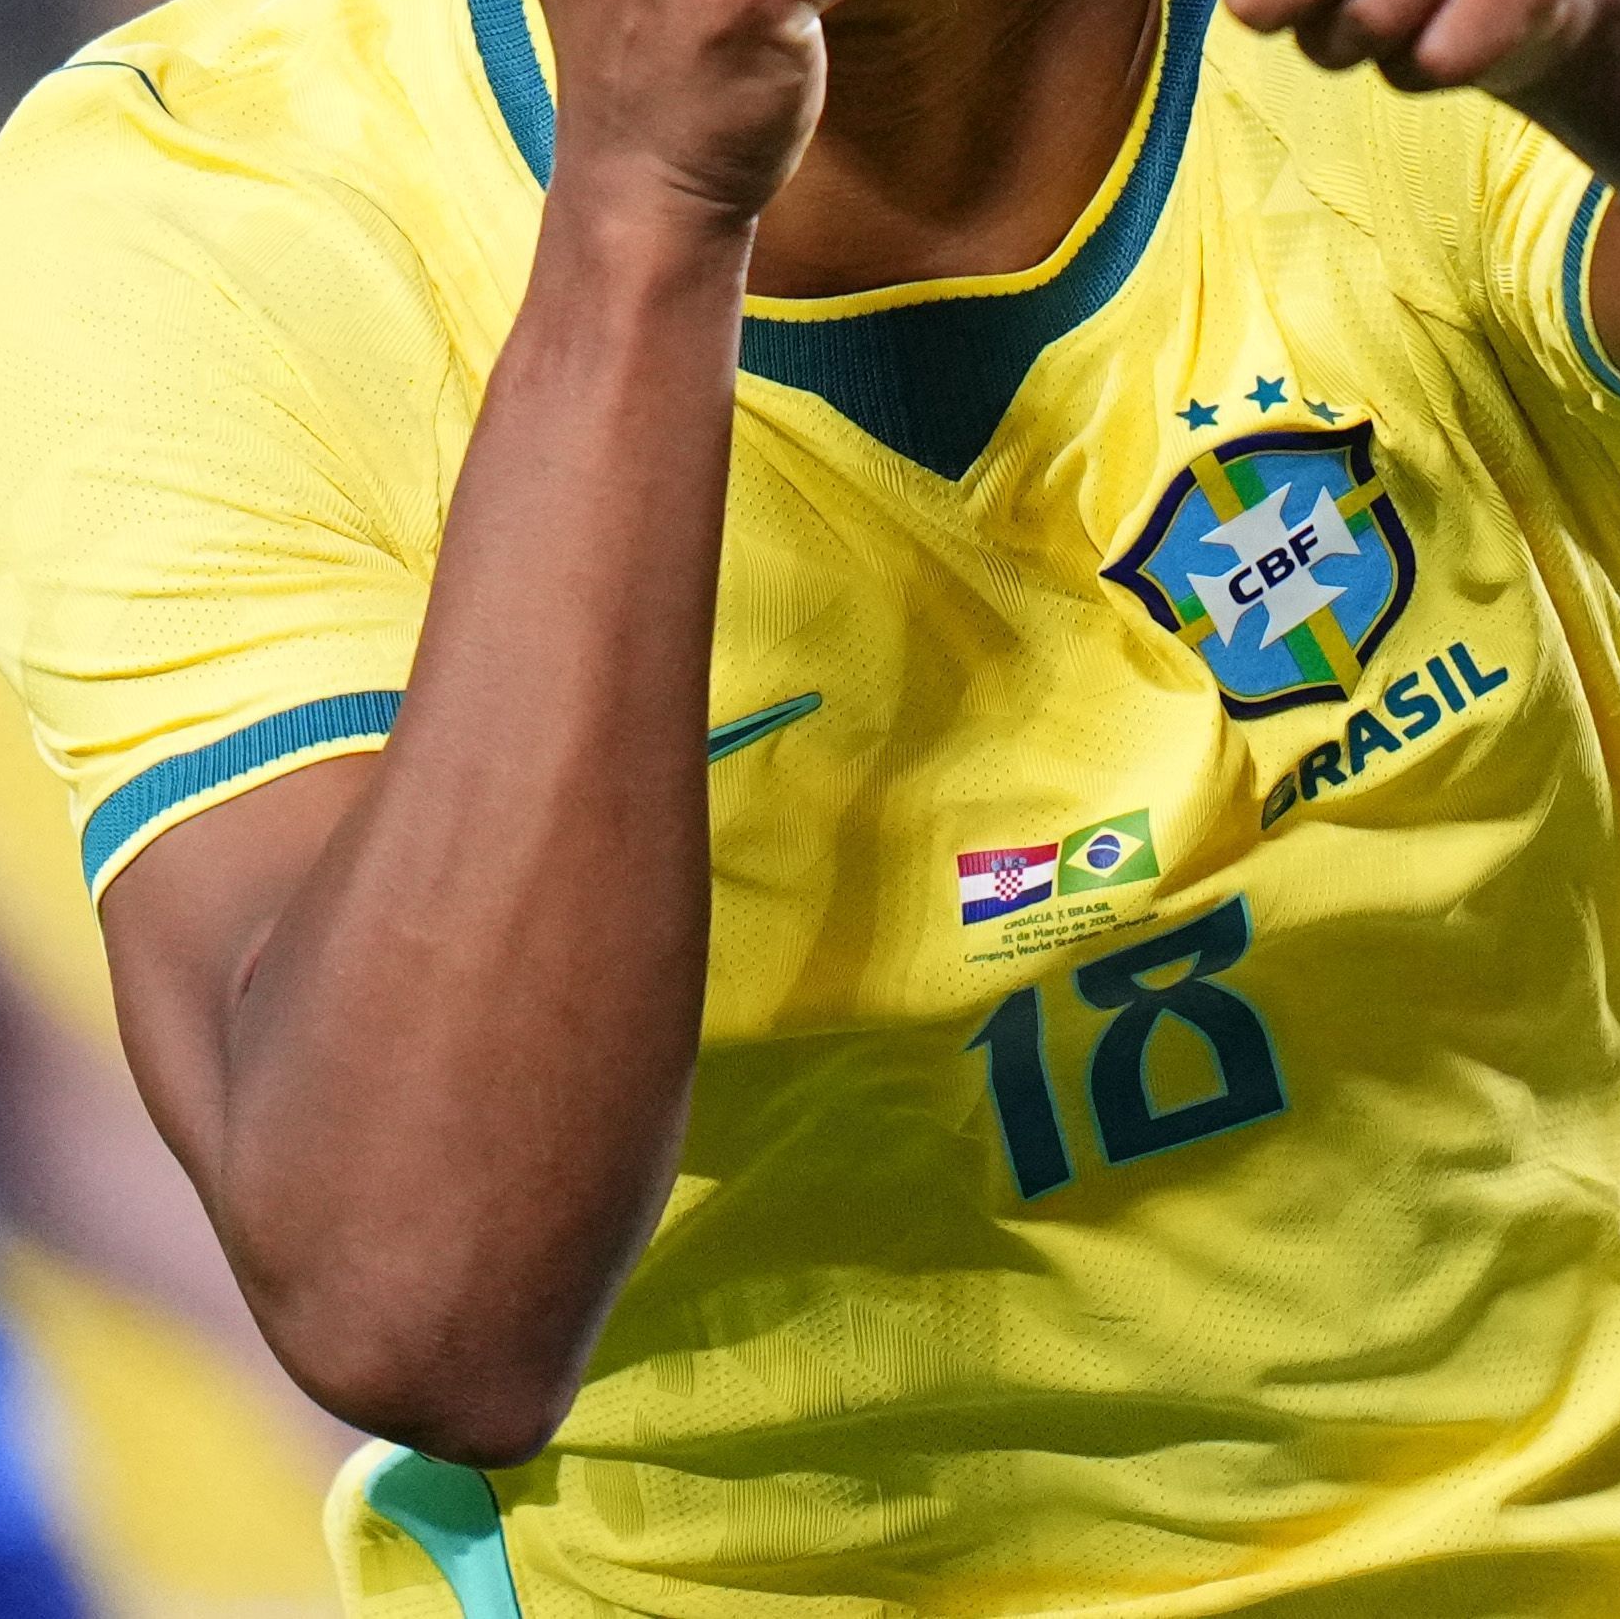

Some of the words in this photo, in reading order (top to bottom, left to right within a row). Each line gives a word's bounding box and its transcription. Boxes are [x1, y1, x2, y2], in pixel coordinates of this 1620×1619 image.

[1228, 525, 1319, 605] CBF
[1261, 642, 1509, 830] BRASIL
[1017, 931, 1030, 942] de
[1034, 926, 1069, 939] Março
[1072, 921, 1085, 932] de
[1068, 902, 1112, 917] BRASIL
[965, 950, 1013, 963] Camping
[1016, 940, 1052, 956] World
[963, 892, 1288, 1201] 18
